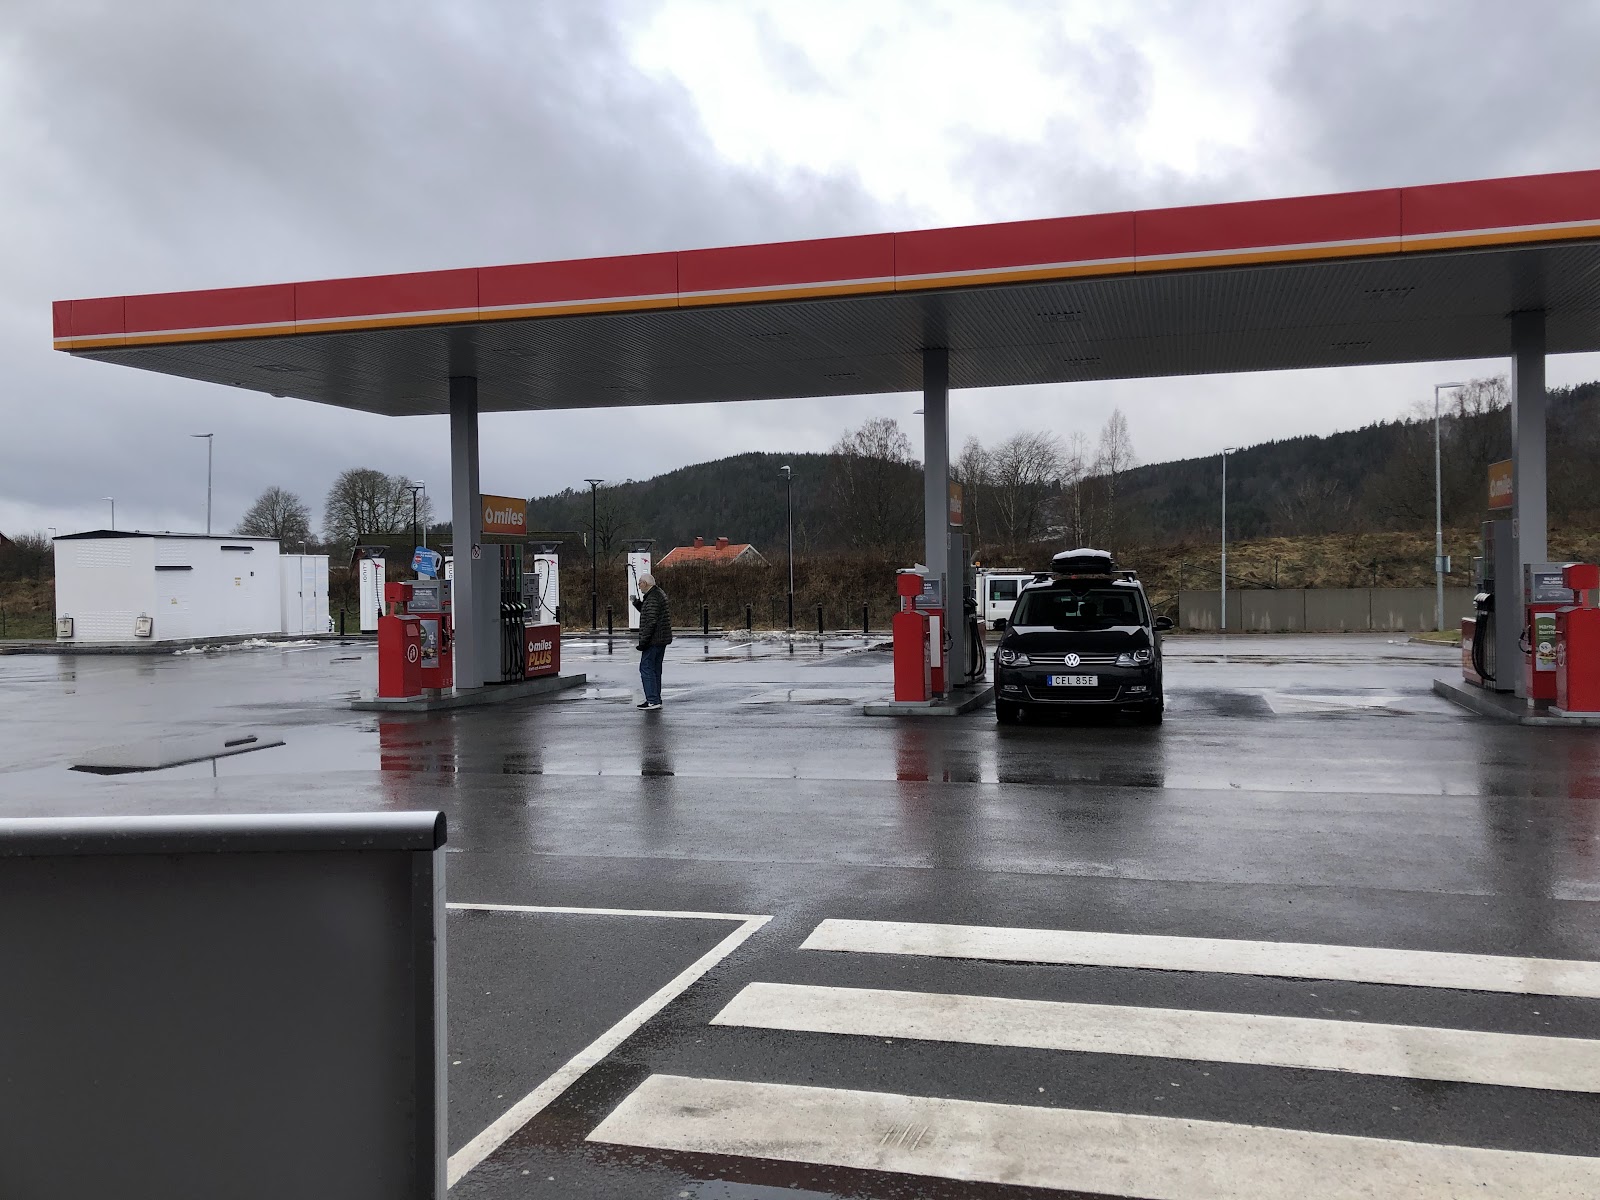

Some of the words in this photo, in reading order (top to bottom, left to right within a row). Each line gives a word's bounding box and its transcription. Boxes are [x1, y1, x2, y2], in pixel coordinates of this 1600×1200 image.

[494, 507, 524, 525] miles
[534, 639, 553, 651] miles
[528, 651, 552, 666] PLUS
[1055, 676, 1073, 685] CEL
